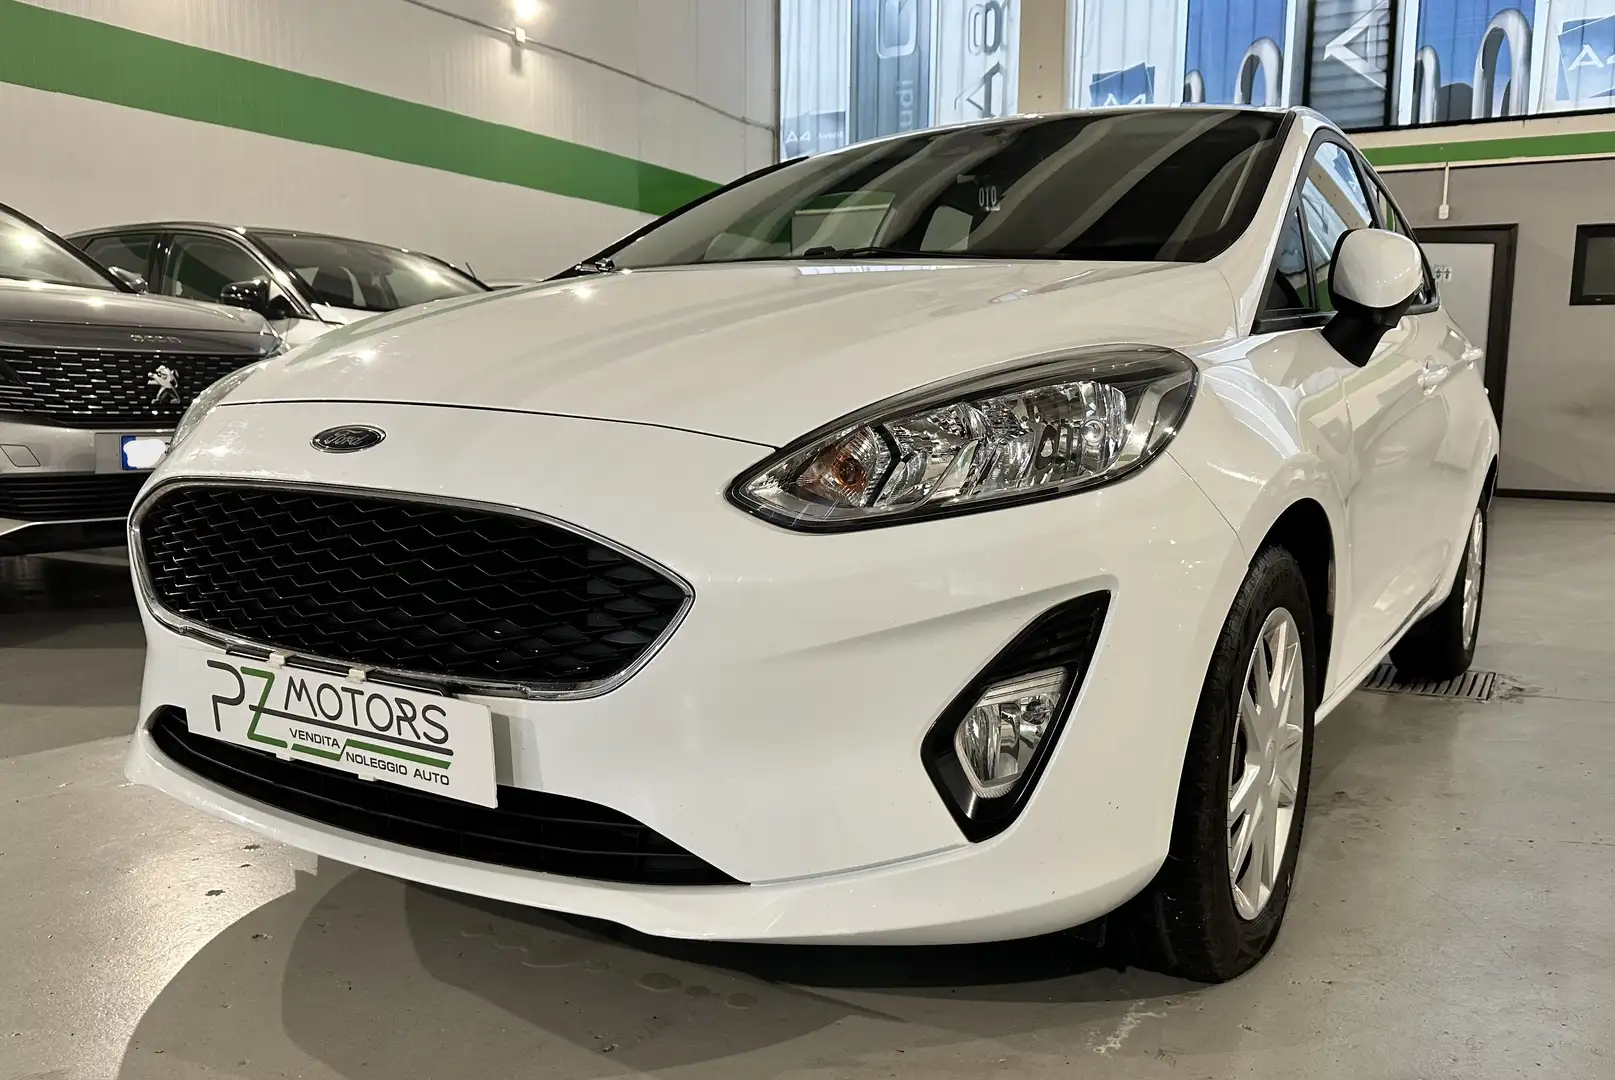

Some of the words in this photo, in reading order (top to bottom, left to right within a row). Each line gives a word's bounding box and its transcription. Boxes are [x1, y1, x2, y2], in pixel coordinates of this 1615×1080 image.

[895, 79, 914, 131] udi
[785, 130, 811, 144] A4
[323, 428, 370, 446] Ford
[206, 659, 289, 749] PZ
[284, 675, 450, 744] MOTORS
[288, 727, 341, 749] VENDITA
[345, 751, 408, 776] NOLEGGIO
[413, 768, 450, 786] AUTO
